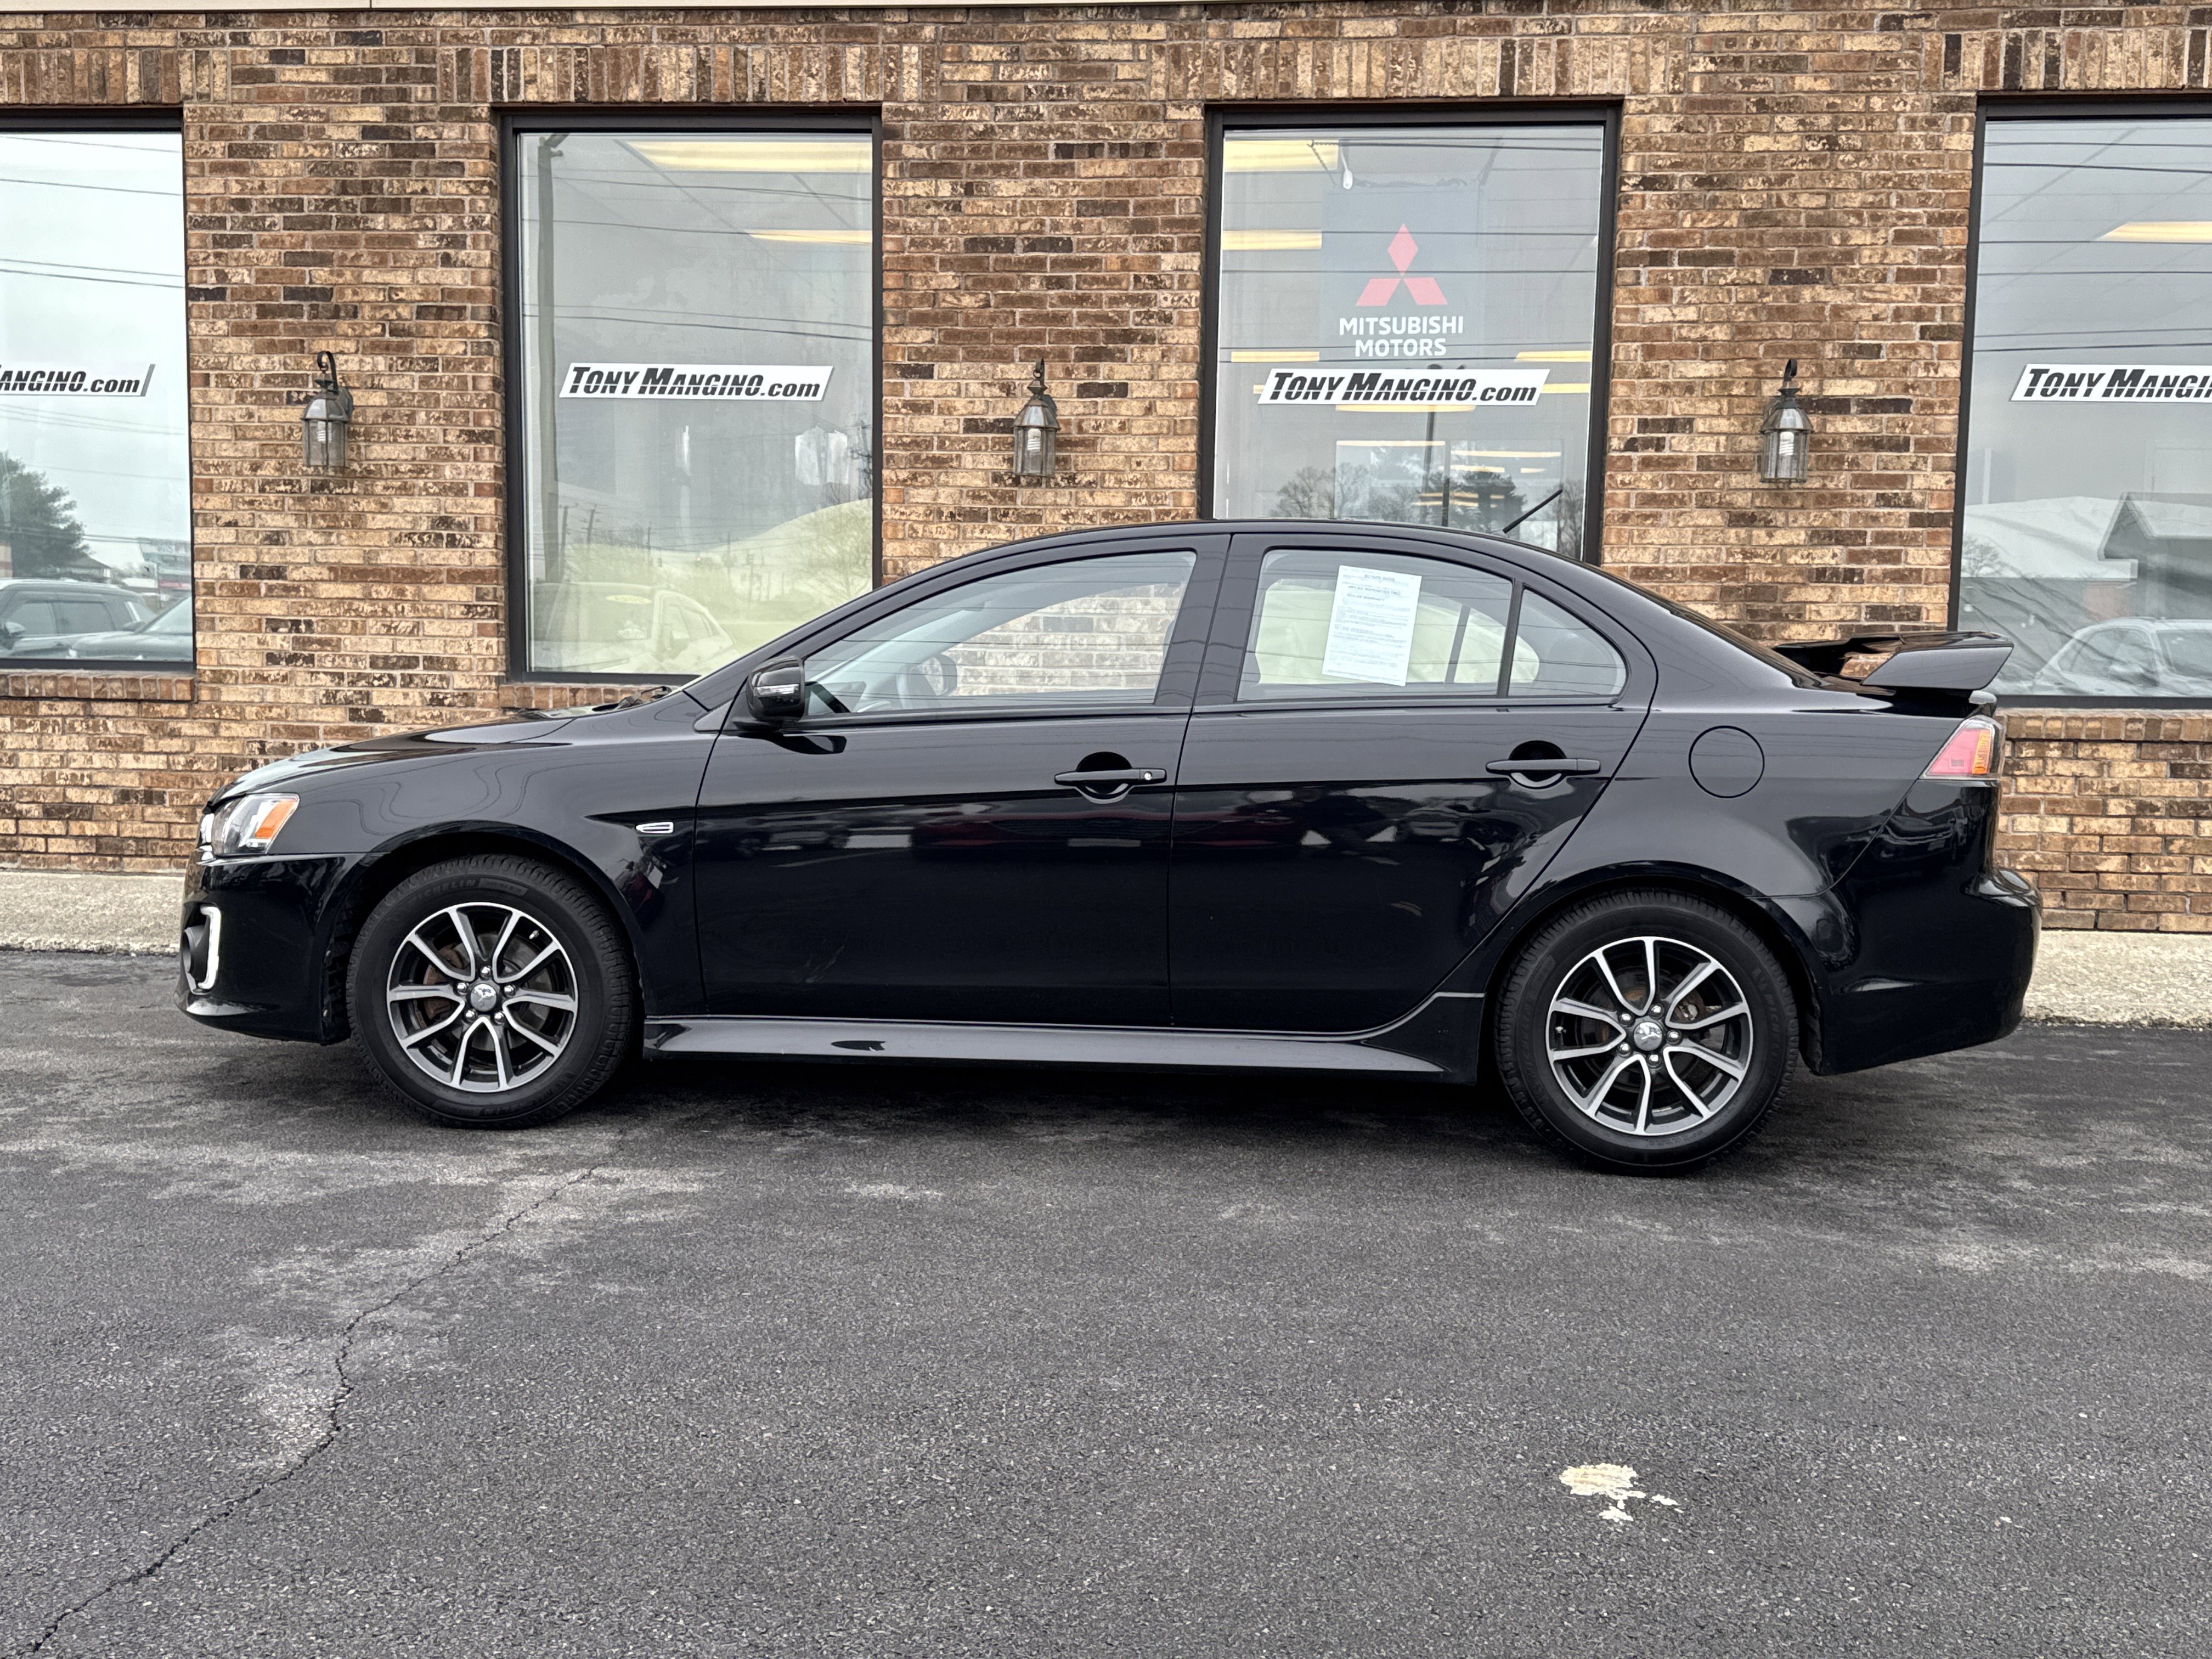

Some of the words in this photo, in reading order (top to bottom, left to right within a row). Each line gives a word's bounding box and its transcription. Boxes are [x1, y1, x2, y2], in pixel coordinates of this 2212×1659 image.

[1339, 315, 1464, 336] MITSUBISHI
[1355, 338, 1447, 357] MOTORS
[0, 370, 140, 393] ANGINO.com
